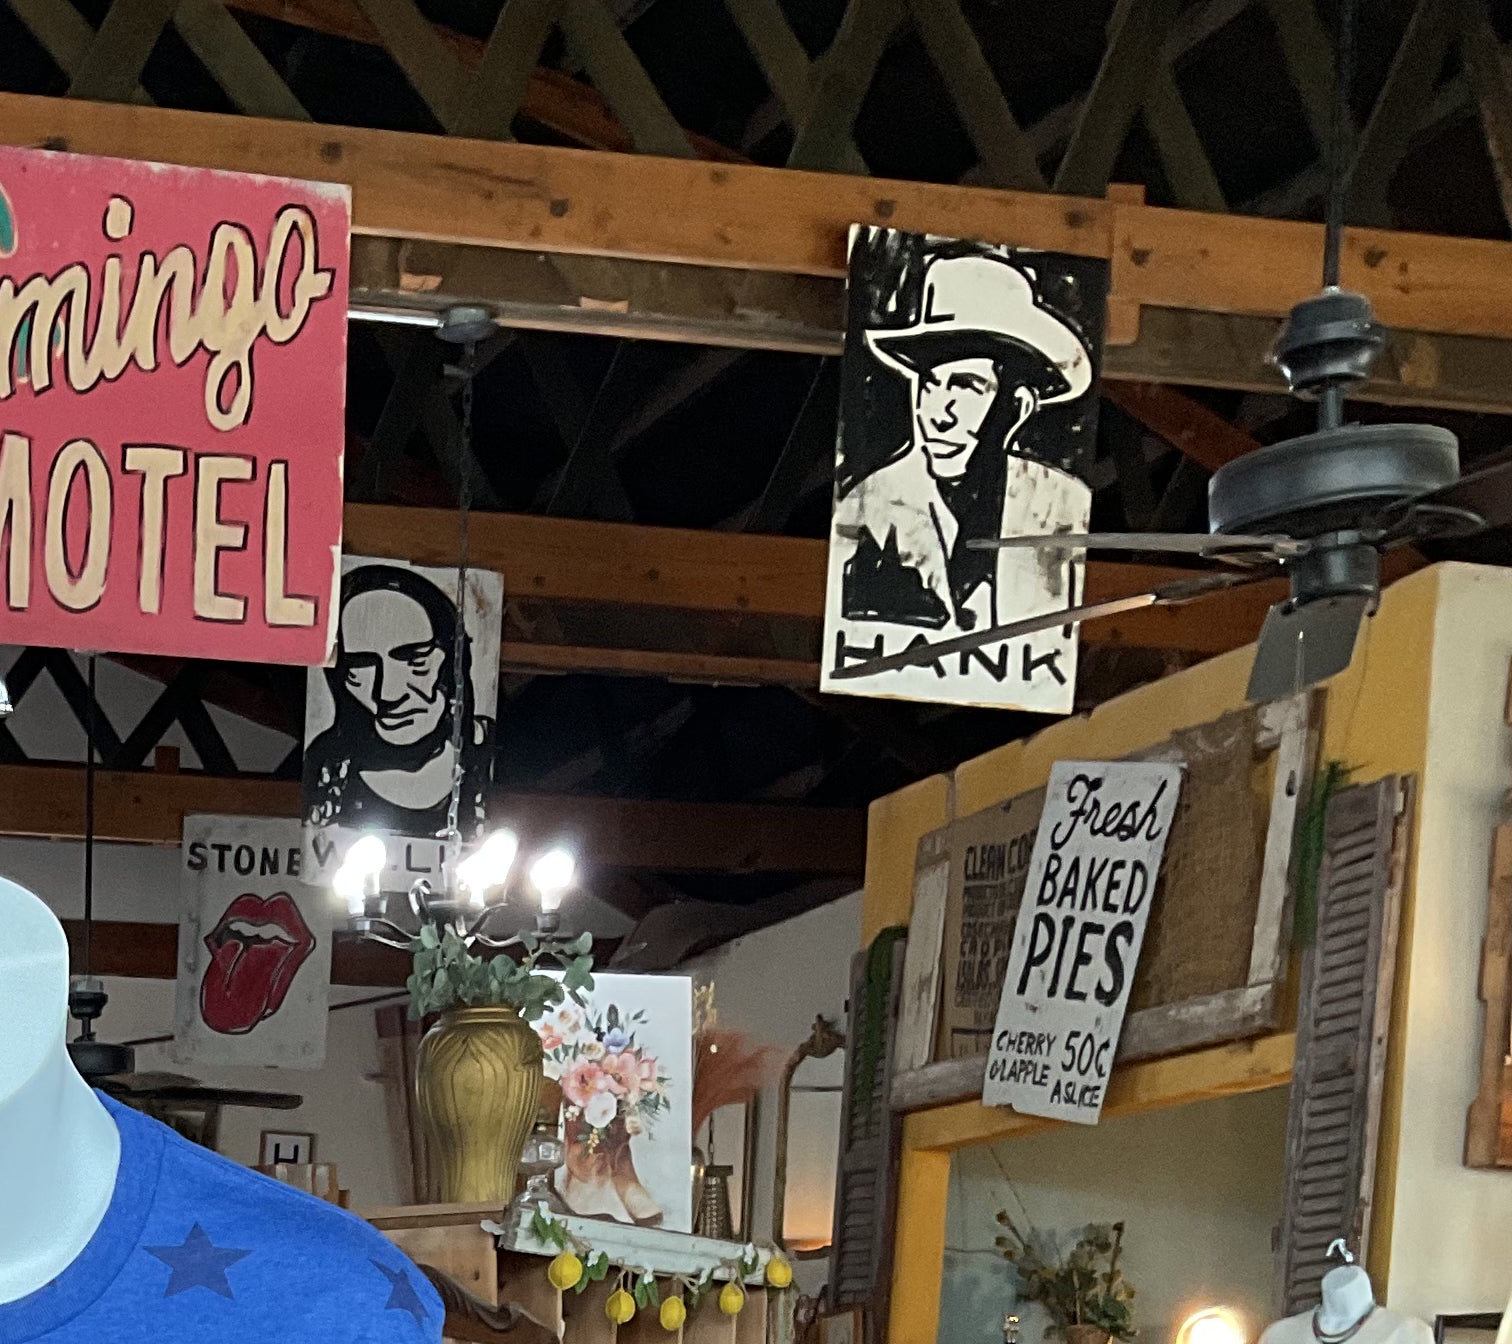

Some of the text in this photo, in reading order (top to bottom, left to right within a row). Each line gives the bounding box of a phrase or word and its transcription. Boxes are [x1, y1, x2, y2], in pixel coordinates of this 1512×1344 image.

[1050, 773, 1169, 851] Fresh
[1035, 852, 1149, 916] BAKED
[1016, 912, 1135, 1008] PIES
[995, 1029, 1057, 1058] CHERRY
[1006, 1059, 1051, 1087] APPLE
[1049, 1078, 1102, 1108] A SLICE
